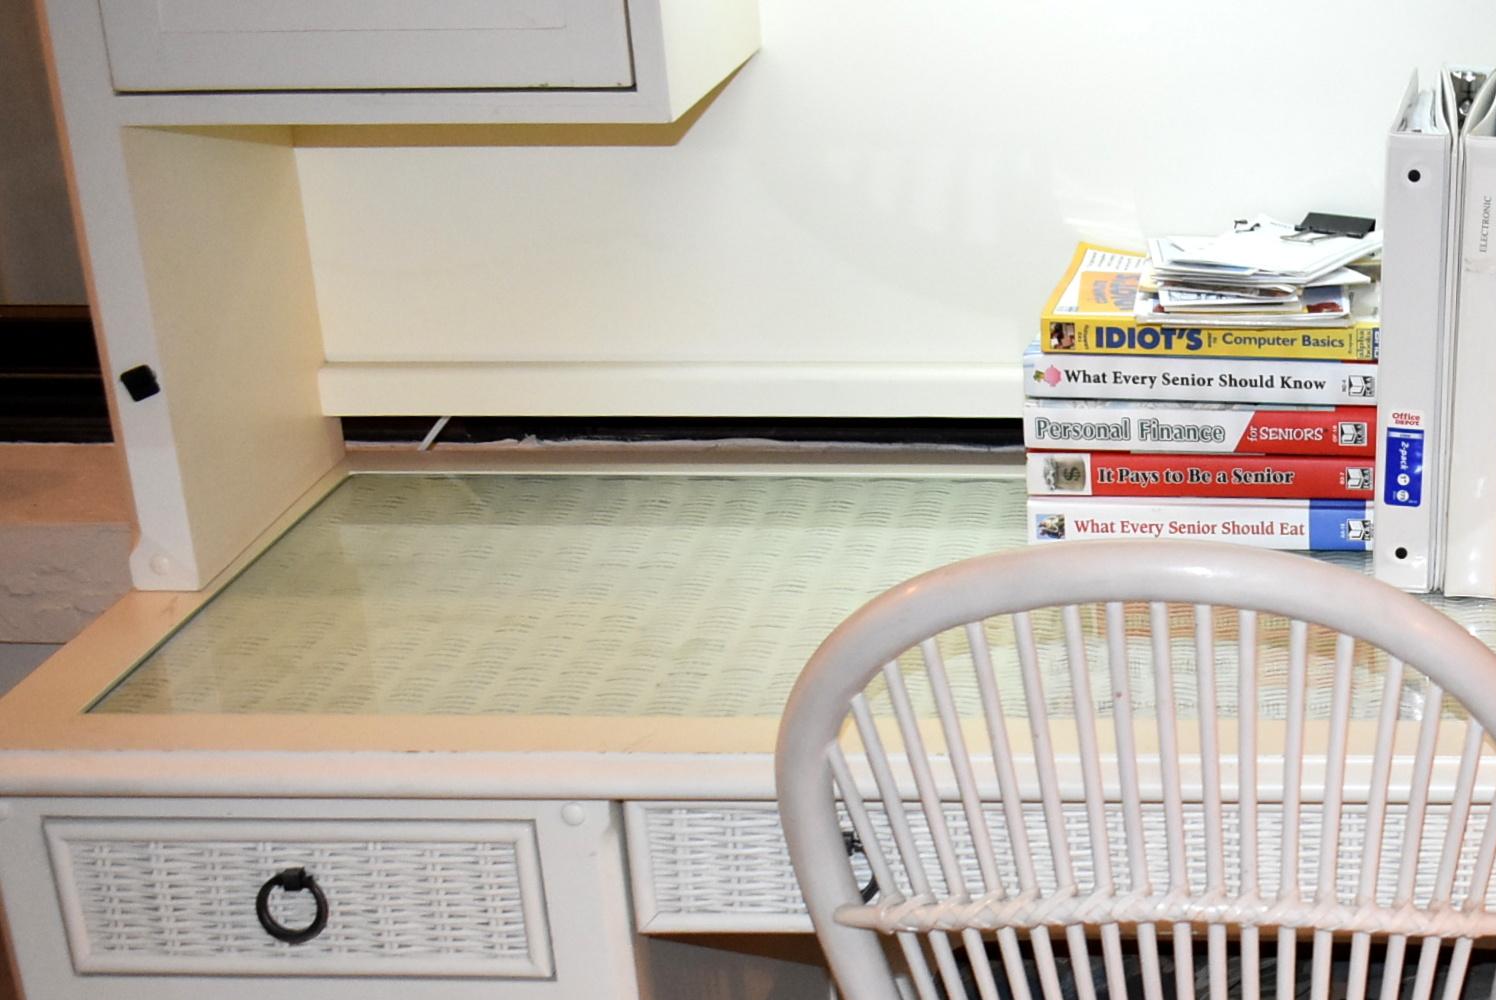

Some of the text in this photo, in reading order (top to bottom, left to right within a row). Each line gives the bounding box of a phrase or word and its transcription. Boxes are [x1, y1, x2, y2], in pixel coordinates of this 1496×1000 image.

[1479, 195, 1492, 253] ELECTRONIC
[1095, 326, 1204, 351] IDIOT'S
[1222, 332, 1297, 349] Computer
[1301, 335, 1345, 348] Basics
[1064, 369, 1108, 384] What
[1112, 371, 1157, 389] Every
[1162, 372, 1214, 387] Senior
[1219, 373, 1275, 389] Should
[1280, 375, 1326, 390] Know
[1392, 412, 1421, 420] Office
[1035, 416, 1226, 443] Personal Finance
[1248, 426, 1258, 442] for
[1259, 426, 1324, 441] SENIORS
[1398, 440, 1410, 470] 2-pack
[1098, 467, 1295, 488] It Pays to Be a Senior
[1074, 519, 1305, 538] What Every Senior Should Eat
